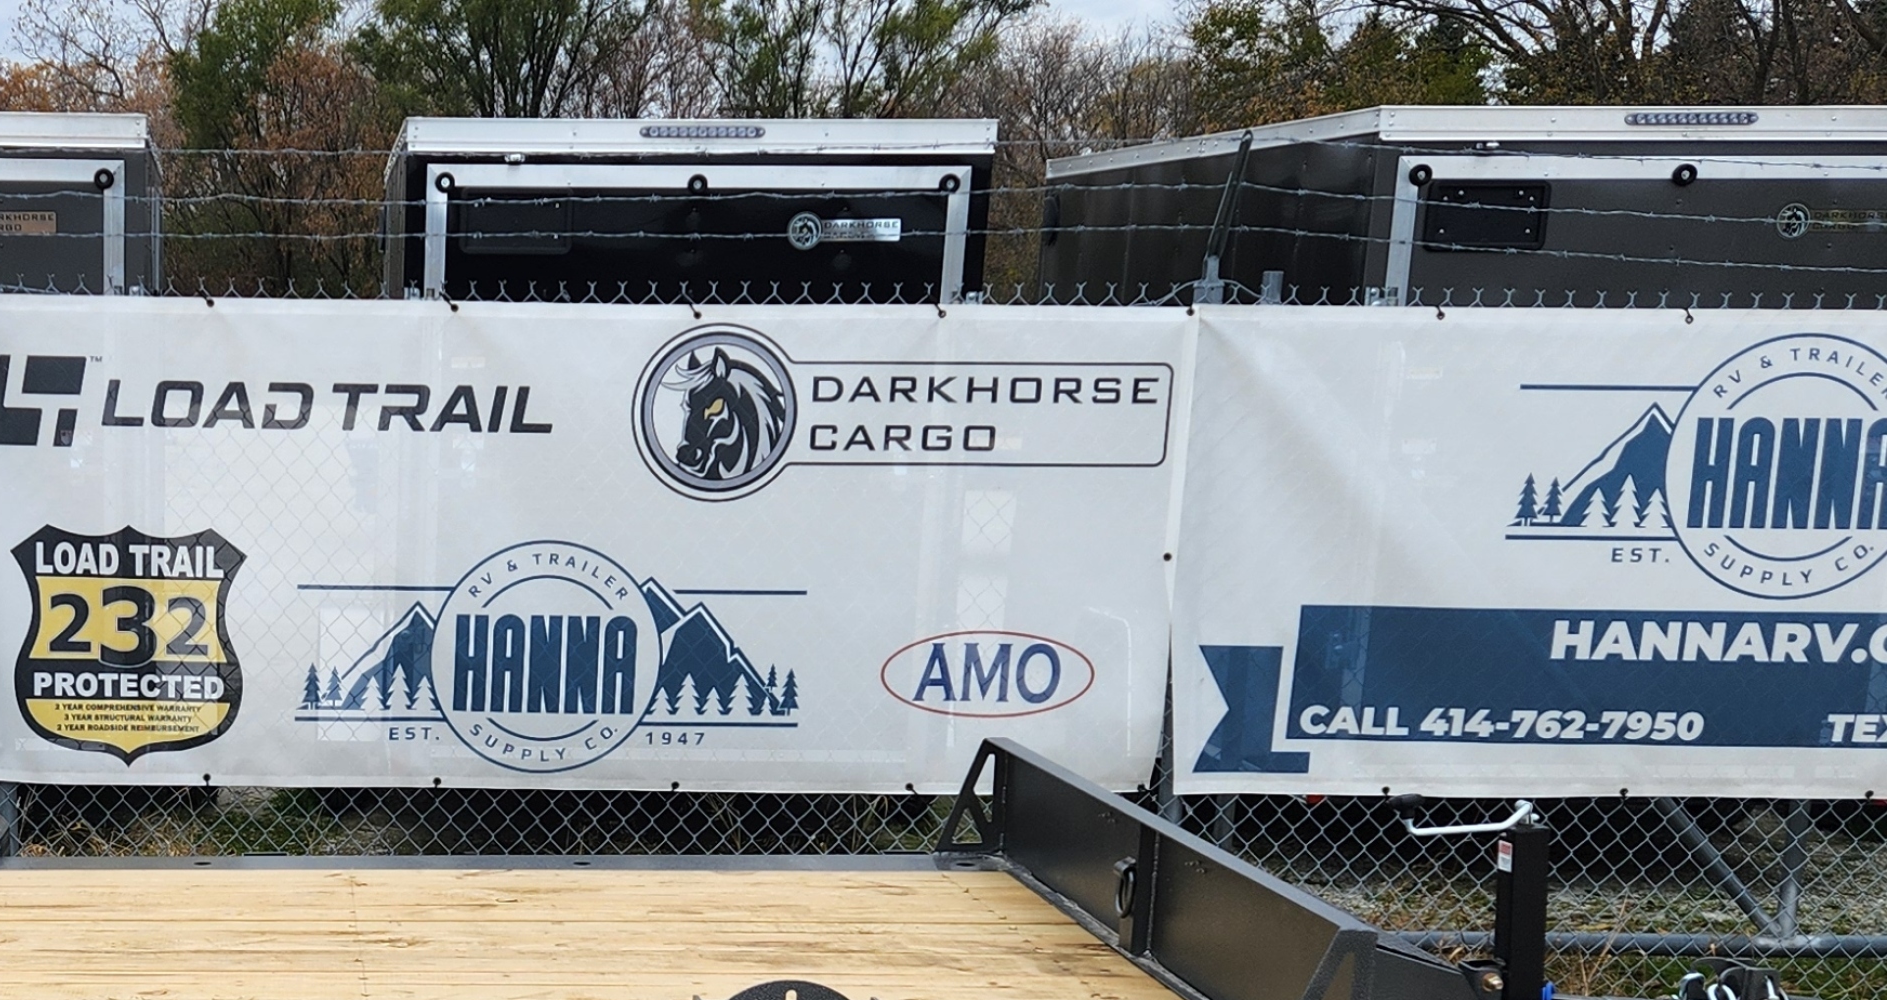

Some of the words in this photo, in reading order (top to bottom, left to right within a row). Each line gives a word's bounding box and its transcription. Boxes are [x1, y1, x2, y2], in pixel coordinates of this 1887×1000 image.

[823, 221, 899, 229] DARKHORSE
[811, 375, 1160, 405] DARKHORSE
[1713, 370, 1742, 398] RV
[1760, 355, 1773, 369] &
[101, 379, 314, 429] LOAD
[332, 383, 553, 433] TRAIL
[809, 424, 997, 452] CARGO
[1687, 417, 1887, 529] HANNA
[35, 541, 119, 575] LOAD
[128, 545, 224, 578] TRAIL
[1611, 547, 1670, 563] EST.
[1704, 542, 1812, 586] SUPPLY
[1834, 544, 1874, 571] CO.
[468, 573, 493, 598] RV
[506, 559, 518, 572] &
[532, 553, 629, 600] TRAILER
[48, 585, 209, 667] 232
[453, 614, 638, 715] HANNA
[913, 642, 1062, 704] AMO
[33, 672, 224, 700] PROTECTED
[55, 703, 60, 711] 2
[63, 703, 83, 711] YEAR
[85, 703, 154, 711] COMPREHENSIVE
[156, 705, 201, 713] WARRANTY
[64, 713, 69, 721] 3
[71, 713, 92, 721] YEAR
[147, 715, 192, 723] WARRANTY
[1299, 705, 1409, 736] CALL
[1419, 708, 1704, 741] 414-762-7950
[57, 723, 62, 731] 2
[64, 723, 85, 731] YEAR
[130, 724, 199, 732] REIMBURSEMENT
[389, 727, 440, 741] EST.
[469, 724, 566, 762] SUPPLY
[584, 727, 618, 750] CO.
[645, 732, 705, 746] 1947
